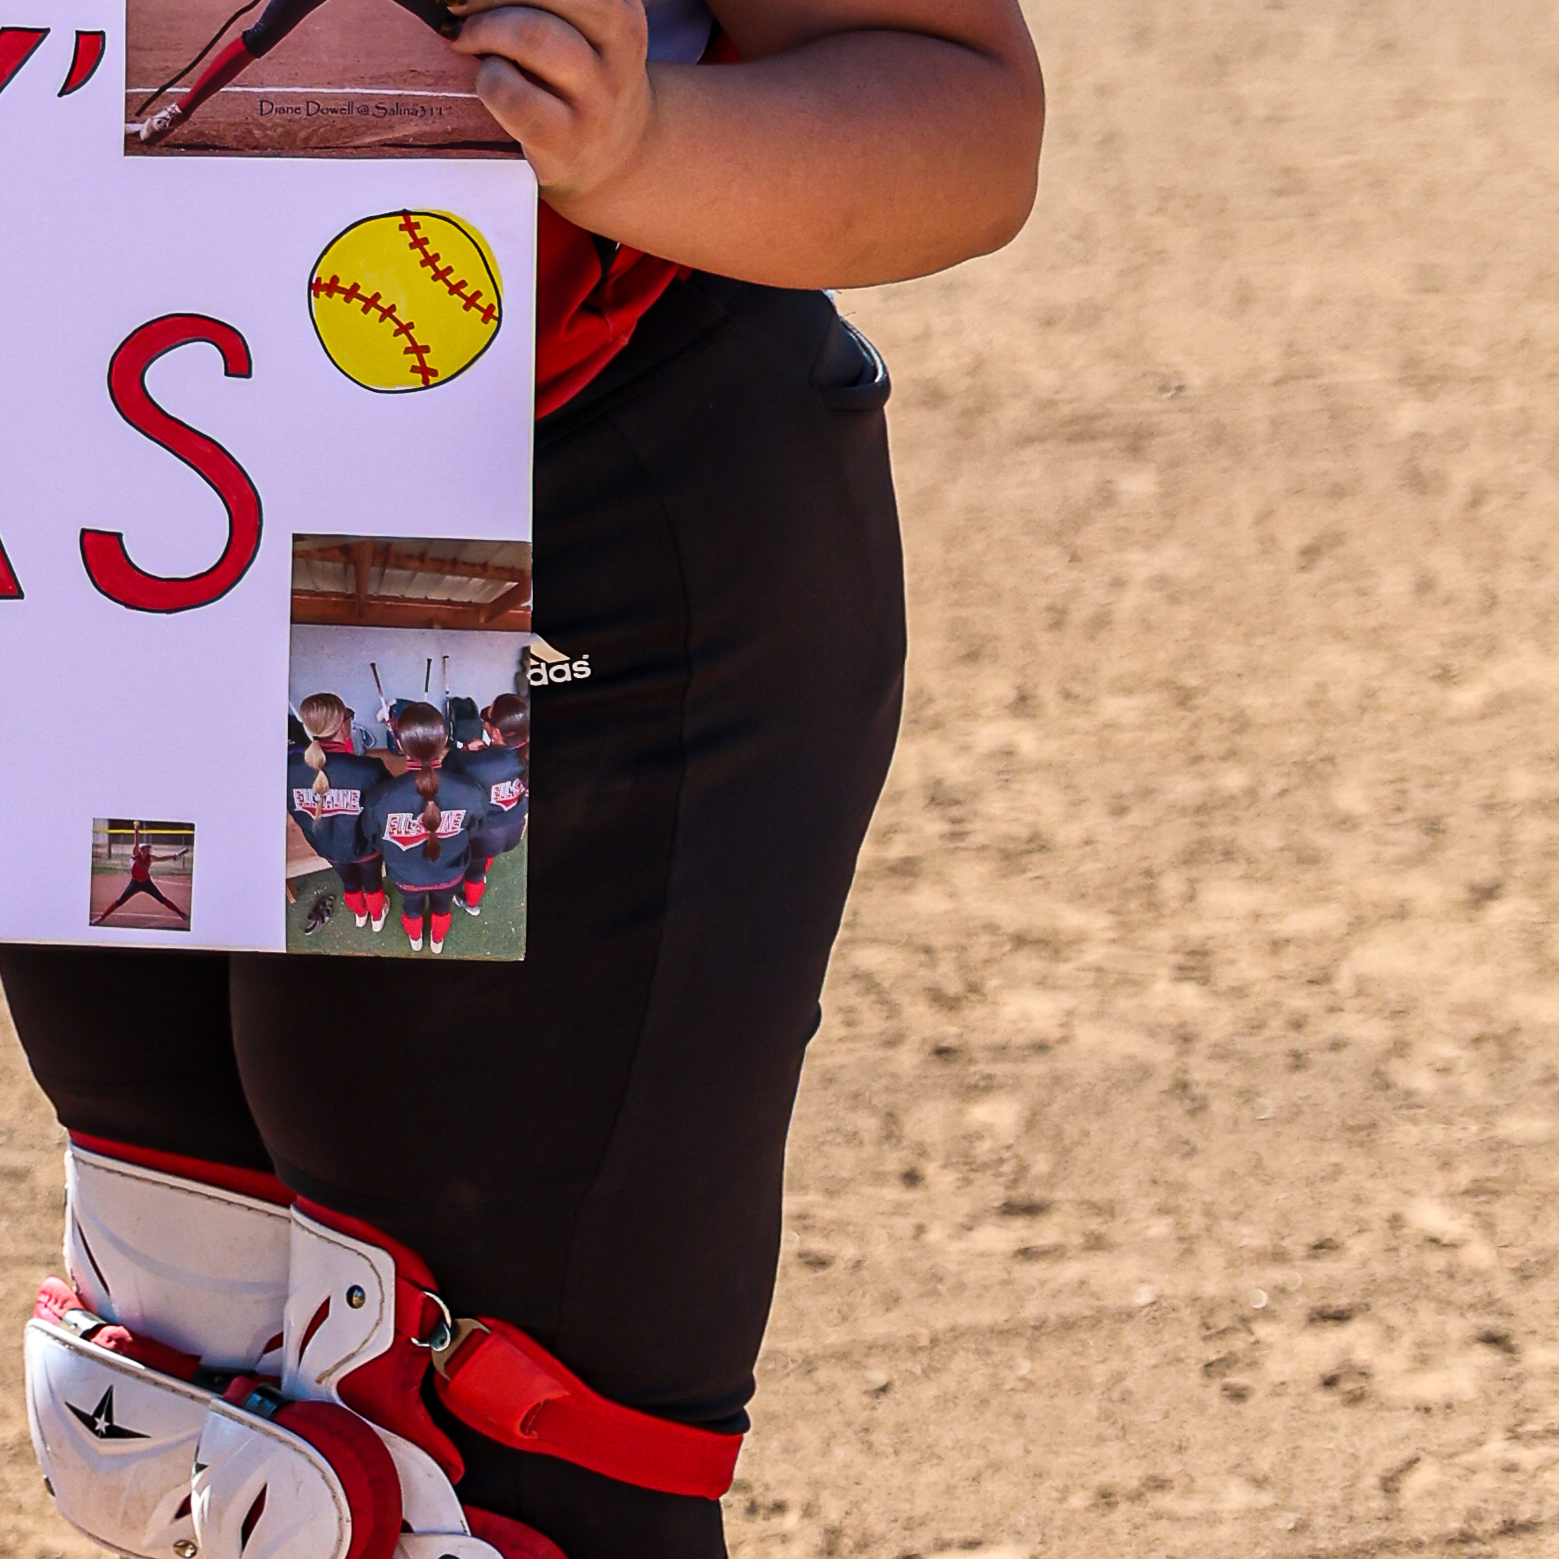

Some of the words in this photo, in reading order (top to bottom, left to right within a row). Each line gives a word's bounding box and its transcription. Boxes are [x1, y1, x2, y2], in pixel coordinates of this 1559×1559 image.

[258, 99, 302, 117] Diane
[305, 100, 354, 117] Dowell
[356, 103, 370, 117] @
